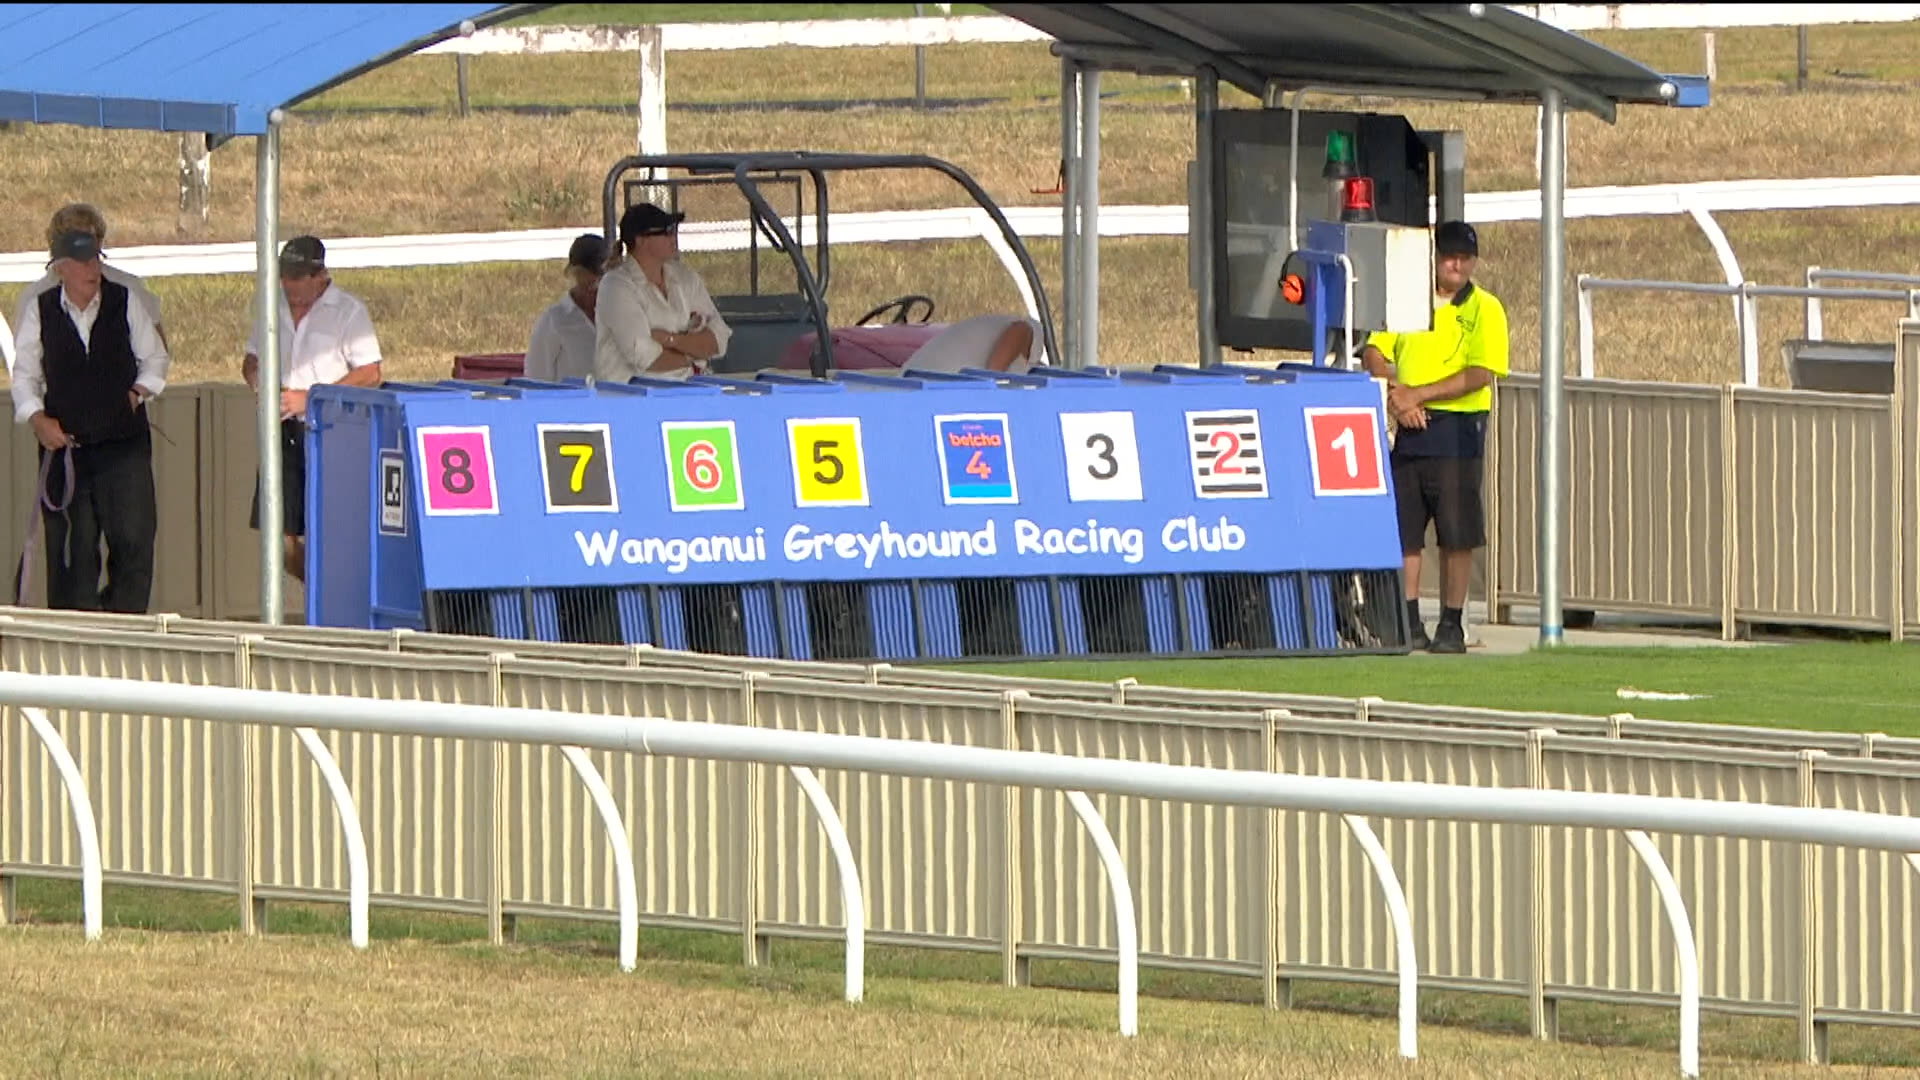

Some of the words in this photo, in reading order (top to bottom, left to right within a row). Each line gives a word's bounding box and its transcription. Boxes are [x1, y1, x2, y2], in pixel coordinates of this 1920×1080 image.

[441, 447, 474, 494] 8
[559, 443, 593, 493] 7
[684, 441, 721, 491] 6
[813, 440, 844, 485] 5
[965, 450, 993, 480] 4
[1086, 433, 1118, 480] 3
[1210, 431, 1243, 474] 2
[1330, 426, 1359, 479] 1
[574, 527, 767, 574] Wanganui
[783, 519, 998, 569] Greyhound
[1013, 519, 1144, 564] Racing
[1161, 516, 1246, 553] Club
